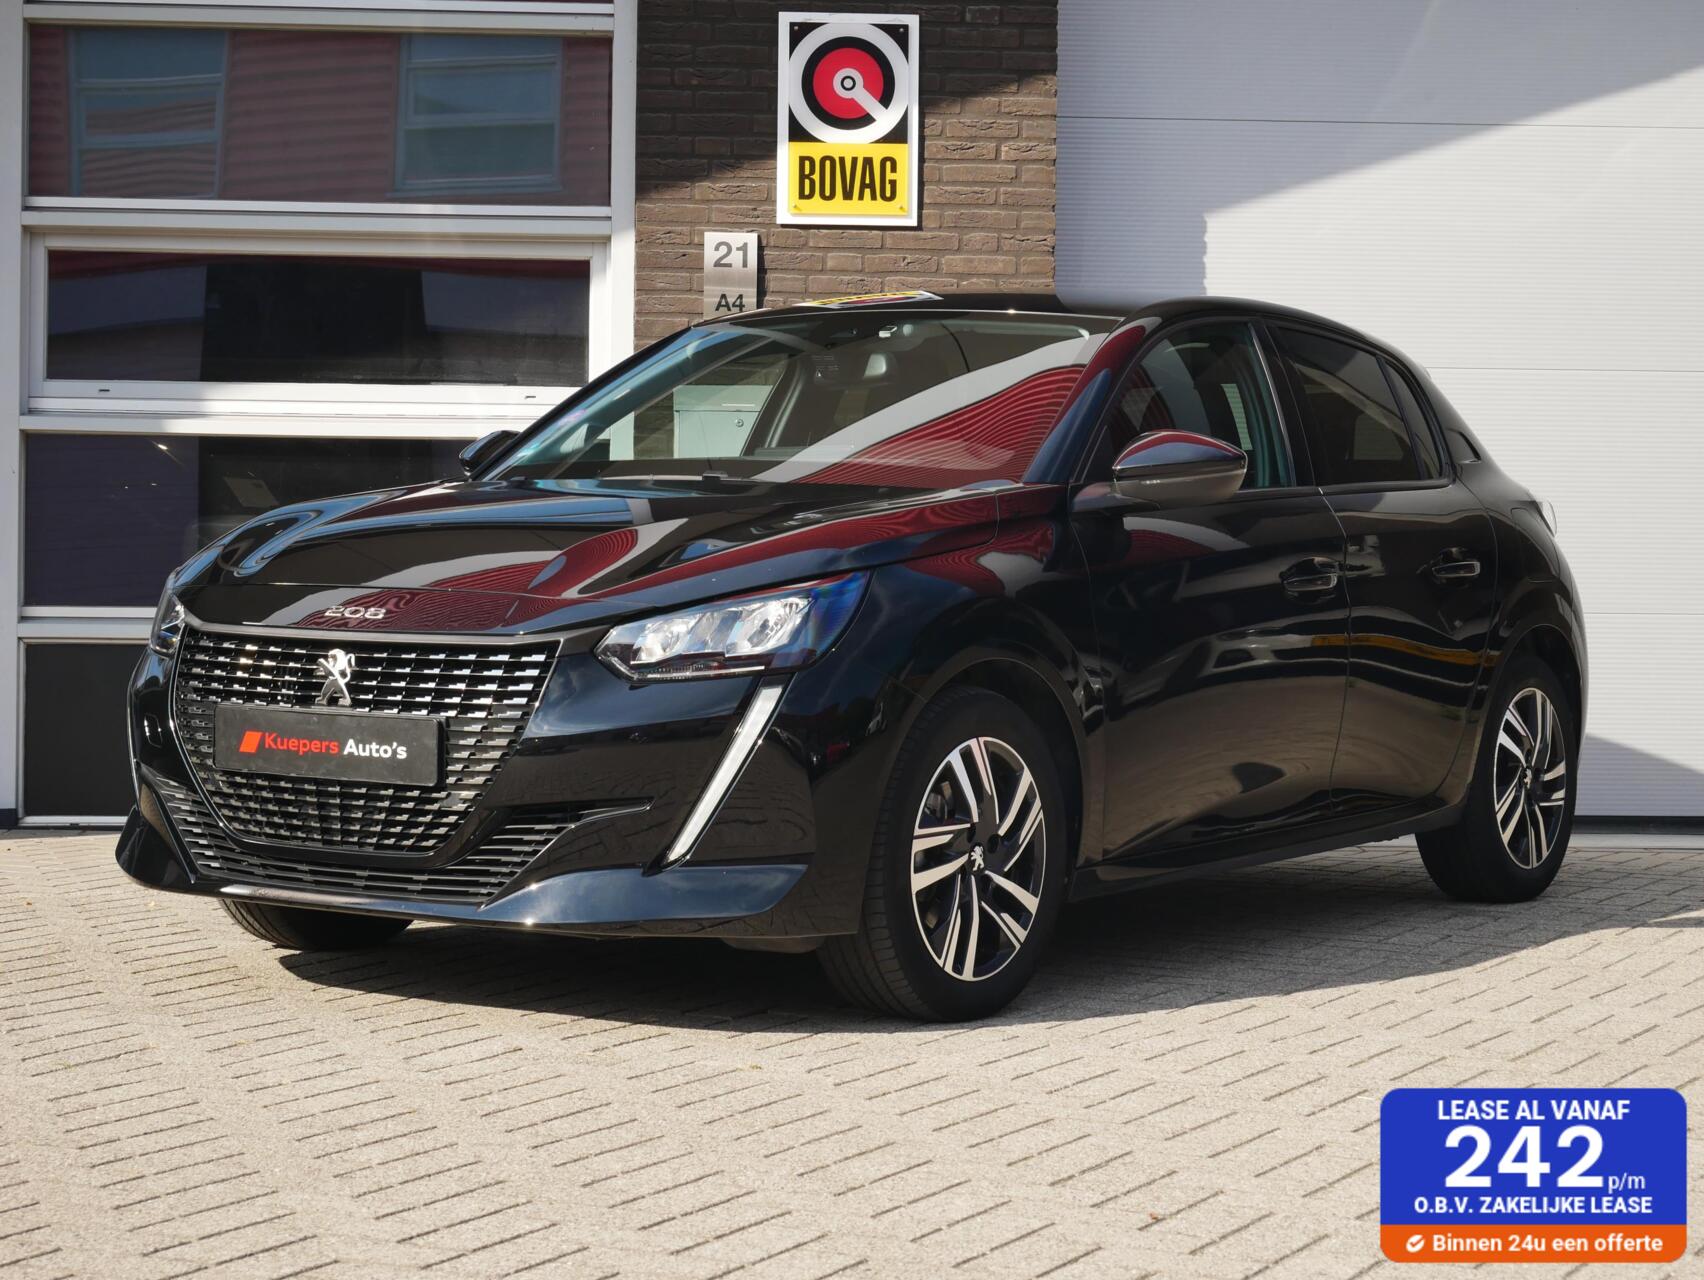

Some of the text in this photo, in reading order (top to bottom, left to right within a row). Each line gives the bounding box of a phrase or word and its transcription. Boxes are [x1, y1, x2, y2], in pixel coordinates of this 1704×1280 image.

[798, 155, 897, 202] BOVAG
[713, 241, 748, 268] 21
[715, 293, 745, 313] A4
[324, 605, 386, 619] 208
[264, 732, 408, 760] Kuepers Auto's
